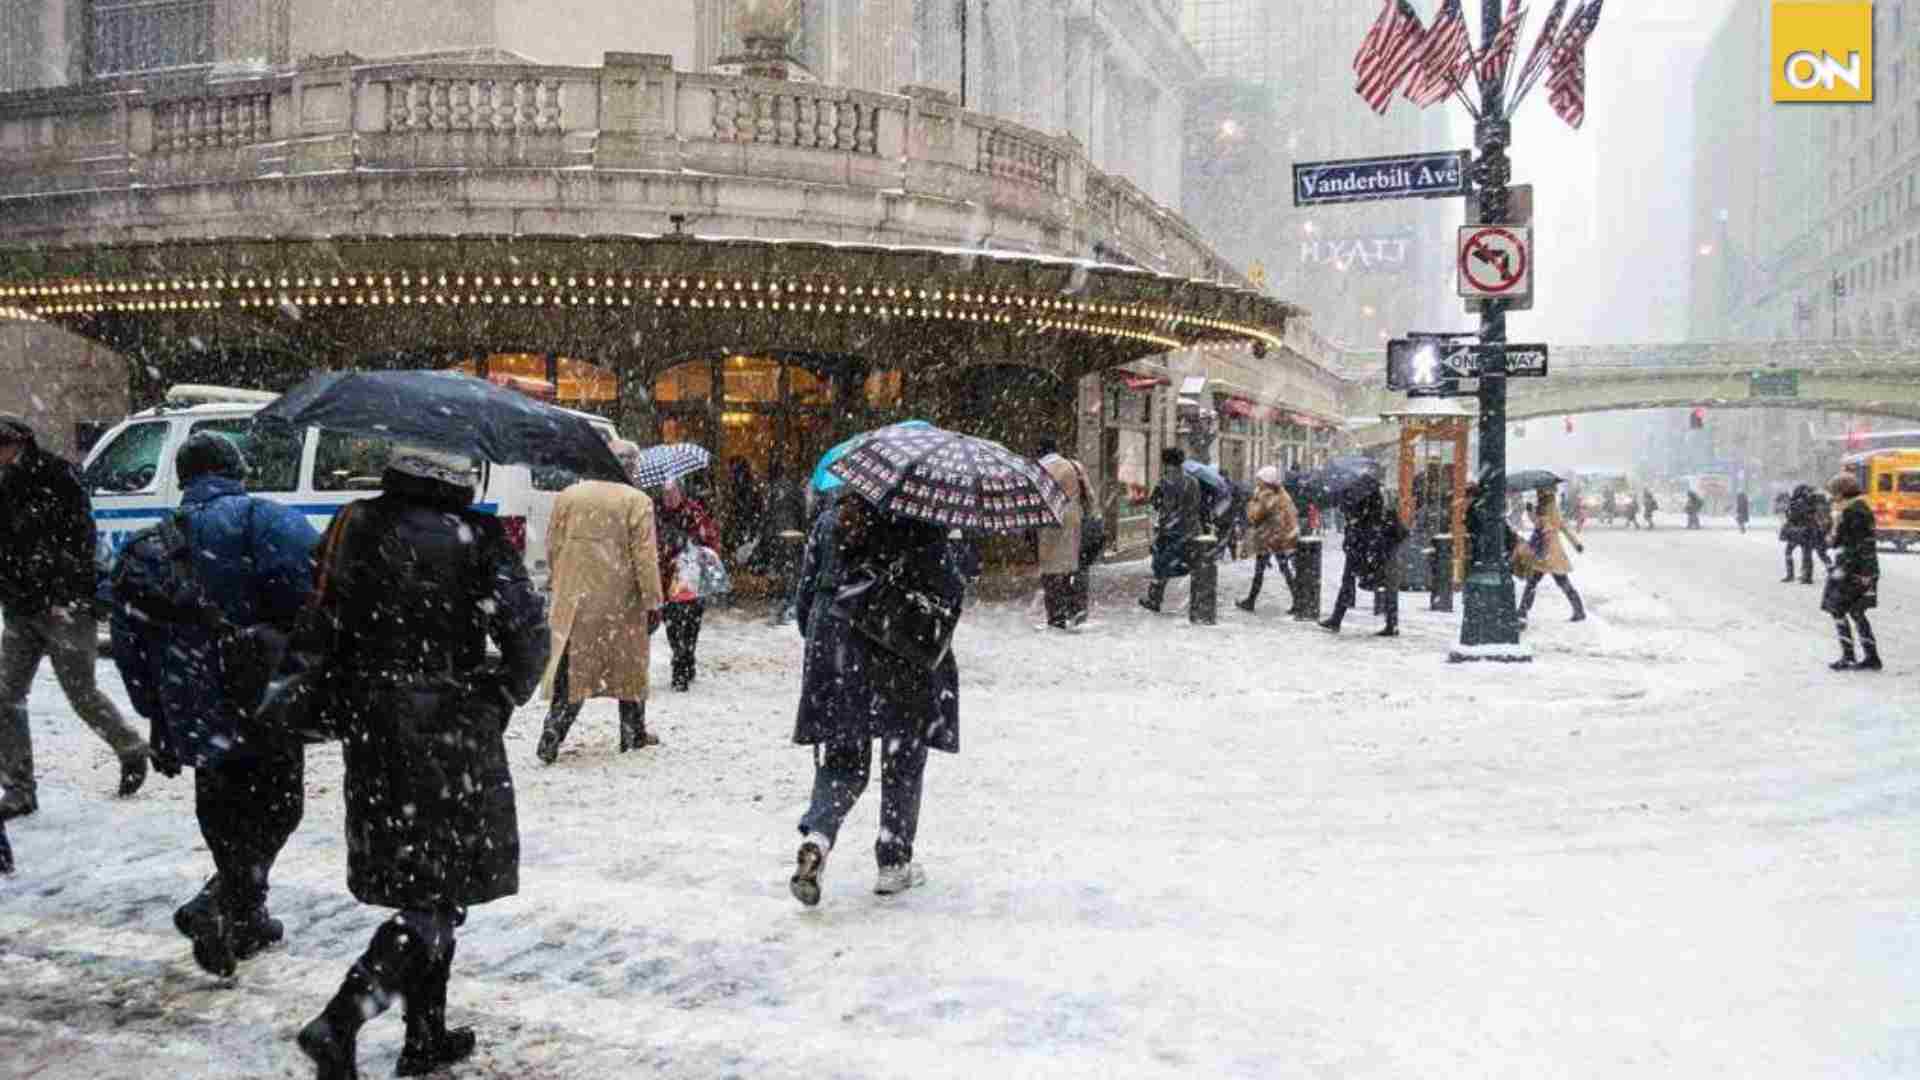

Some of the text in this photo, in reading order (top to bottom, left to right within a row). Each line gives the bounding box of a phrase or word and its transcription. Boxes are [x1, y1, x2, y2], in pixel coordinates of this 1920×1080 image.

[1302, 165, 1457, 195] Vanderbilt Ave
[1301, 240, 1406, 265] HYATT
[1505, 352, 1538, 368] WAY
